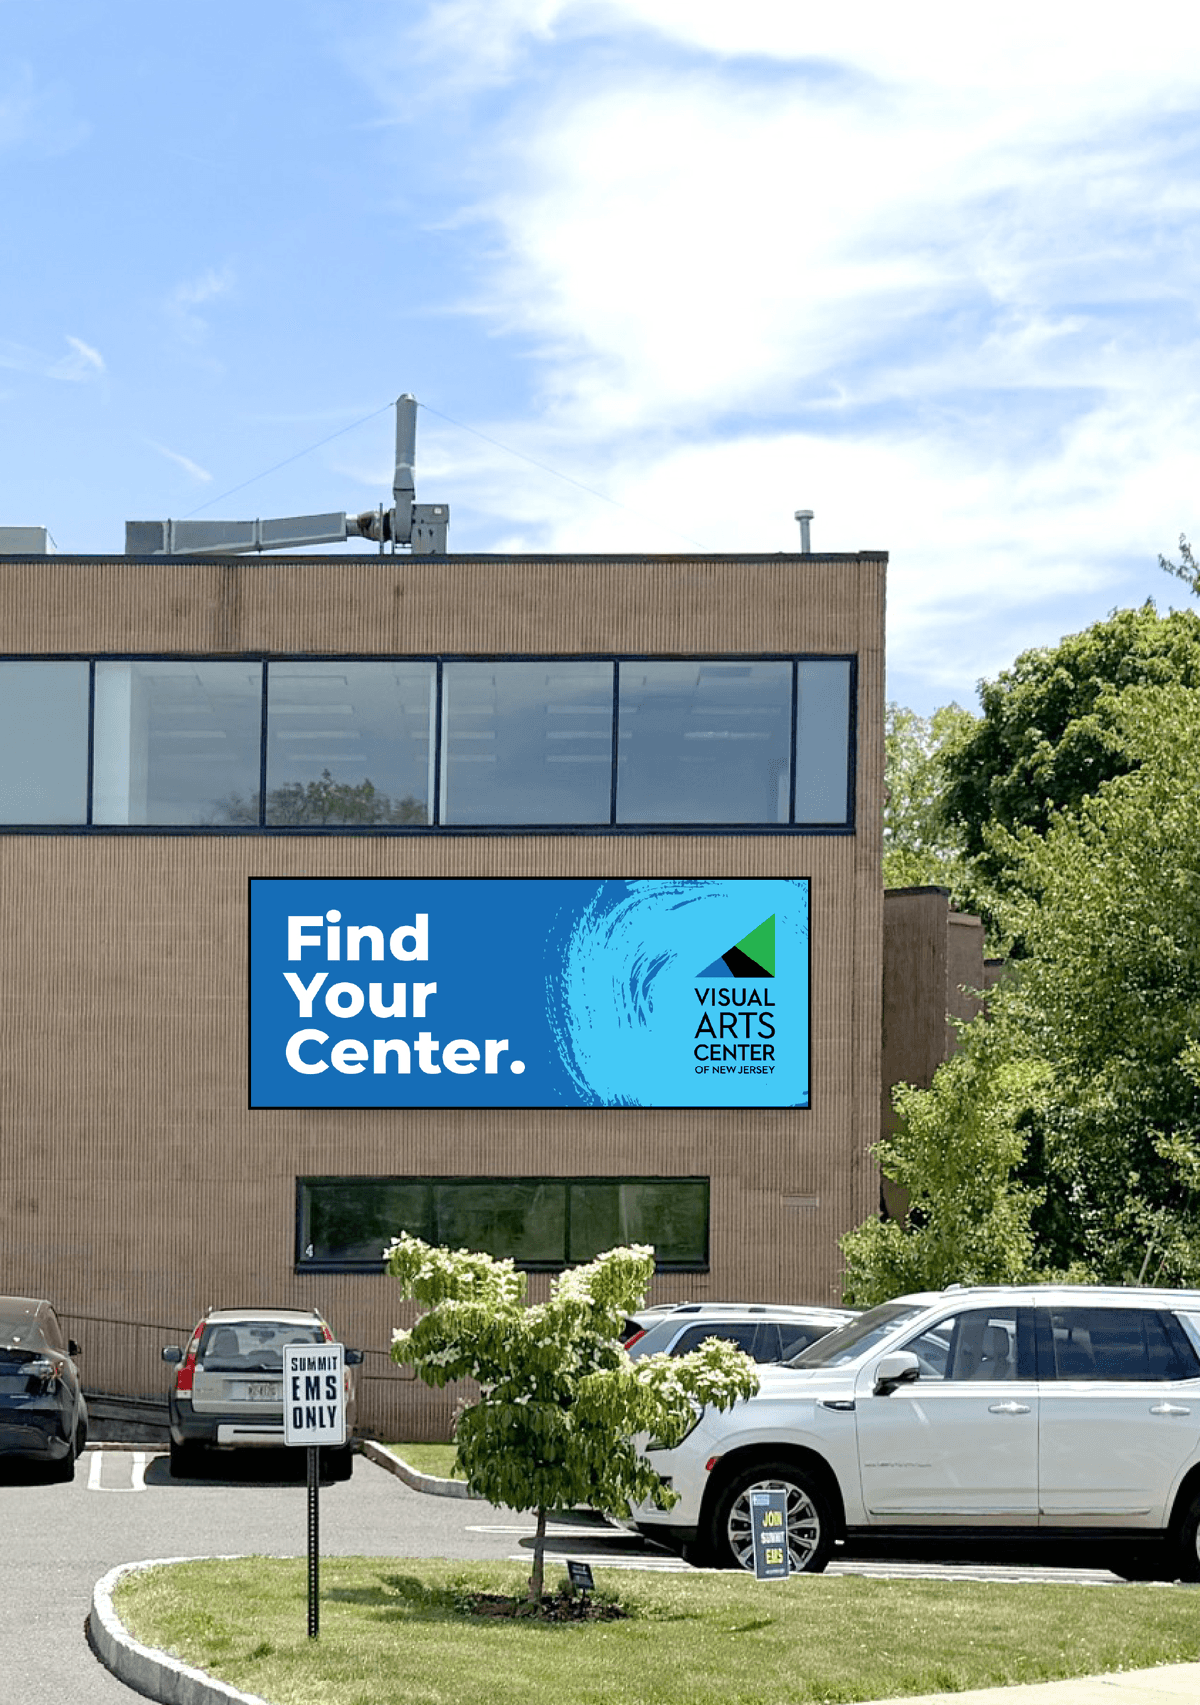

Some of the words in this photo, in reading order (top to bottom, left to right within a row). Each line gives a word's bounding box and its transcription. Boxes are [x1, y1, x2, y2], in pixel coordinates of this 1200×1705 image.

[288, 910, 429, 961] Find
[283, 973, 437, 1019] Your
[695, 988, 776, 1007] VISUAL
[695, 1012, 776, 1040] ARTS
[285, 1029, 526, 1075] Center.
[694, 1044, 776, 1062] CENTER
[694, 1065, 710, 1075] OF
[712, 1065, 736, 1075] NEW
[737, 1065, 776, 1075] JERSEY
[305, 1243, 314, 1257] 4
[291, 1356, 338, 1372] SUMMIT
[291, 1376, 337, 1401] EMS
[293, 1405, 337, 1429] ONLY
